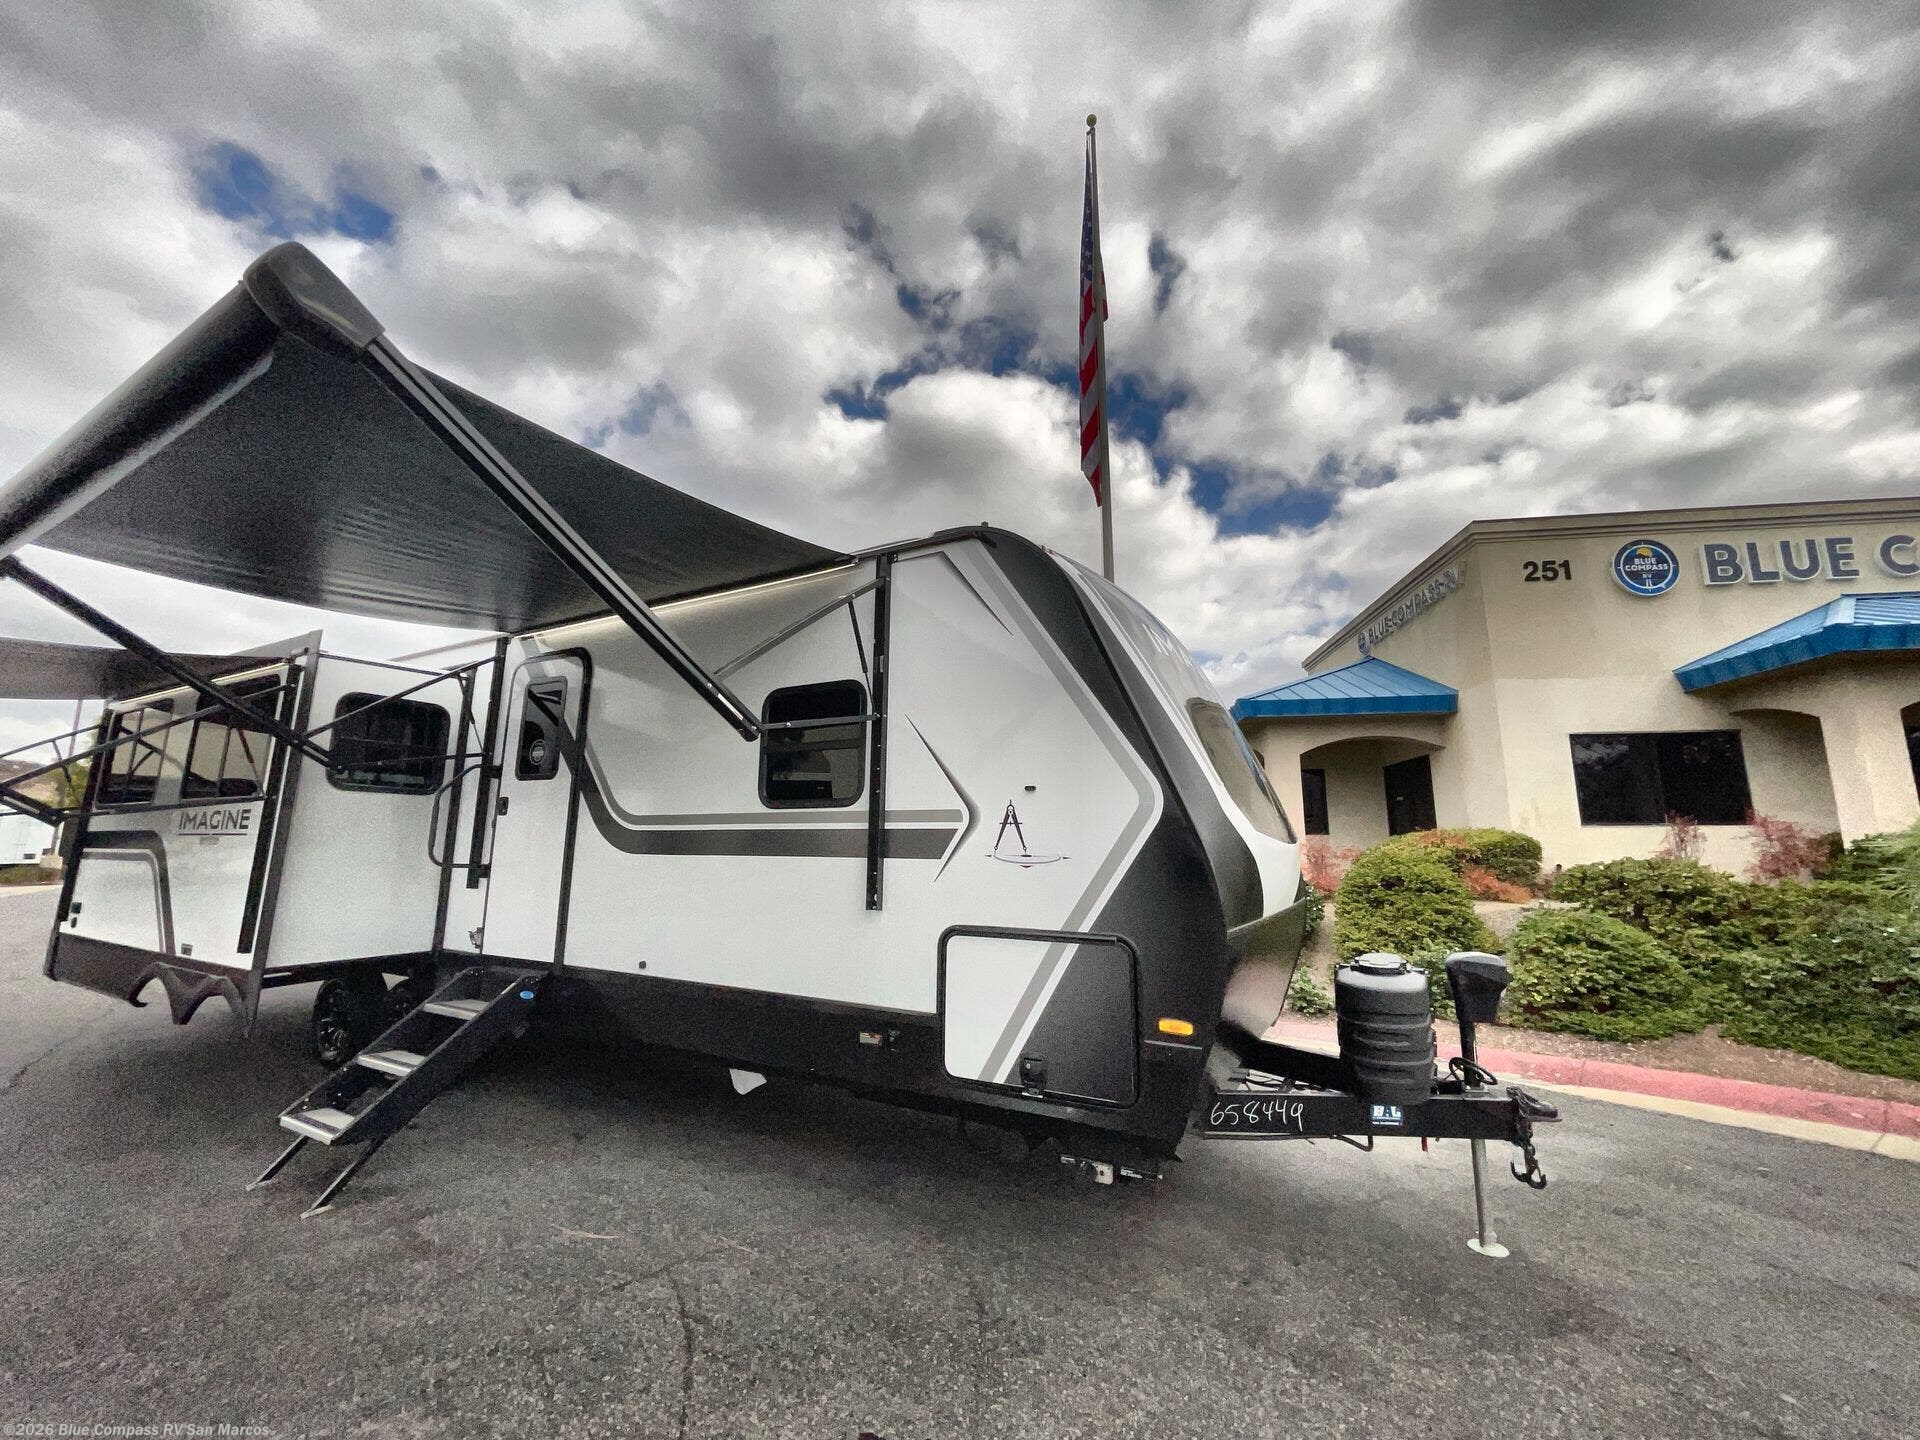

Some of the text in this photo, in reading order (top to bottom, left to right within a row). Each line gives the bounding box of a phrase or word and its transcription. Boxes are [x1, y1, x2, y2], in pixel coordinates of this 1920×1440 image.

[1523, 560, 1572, 582] 251
[1625, 563, 1669, 572] COMPASS
[1634, 557, 1657, 565] BLUE
[1704, 537, 1861, 586] BLUE
[1368, 616, 1393, 645] BLUE
[1391, 579, 1443, 628] COMPASS
[179, 808, 252, 830] IMAGINE
[1210, 1099, 1304, 1132] 658449
[1373, 1105, 1402, 1118] BAL
